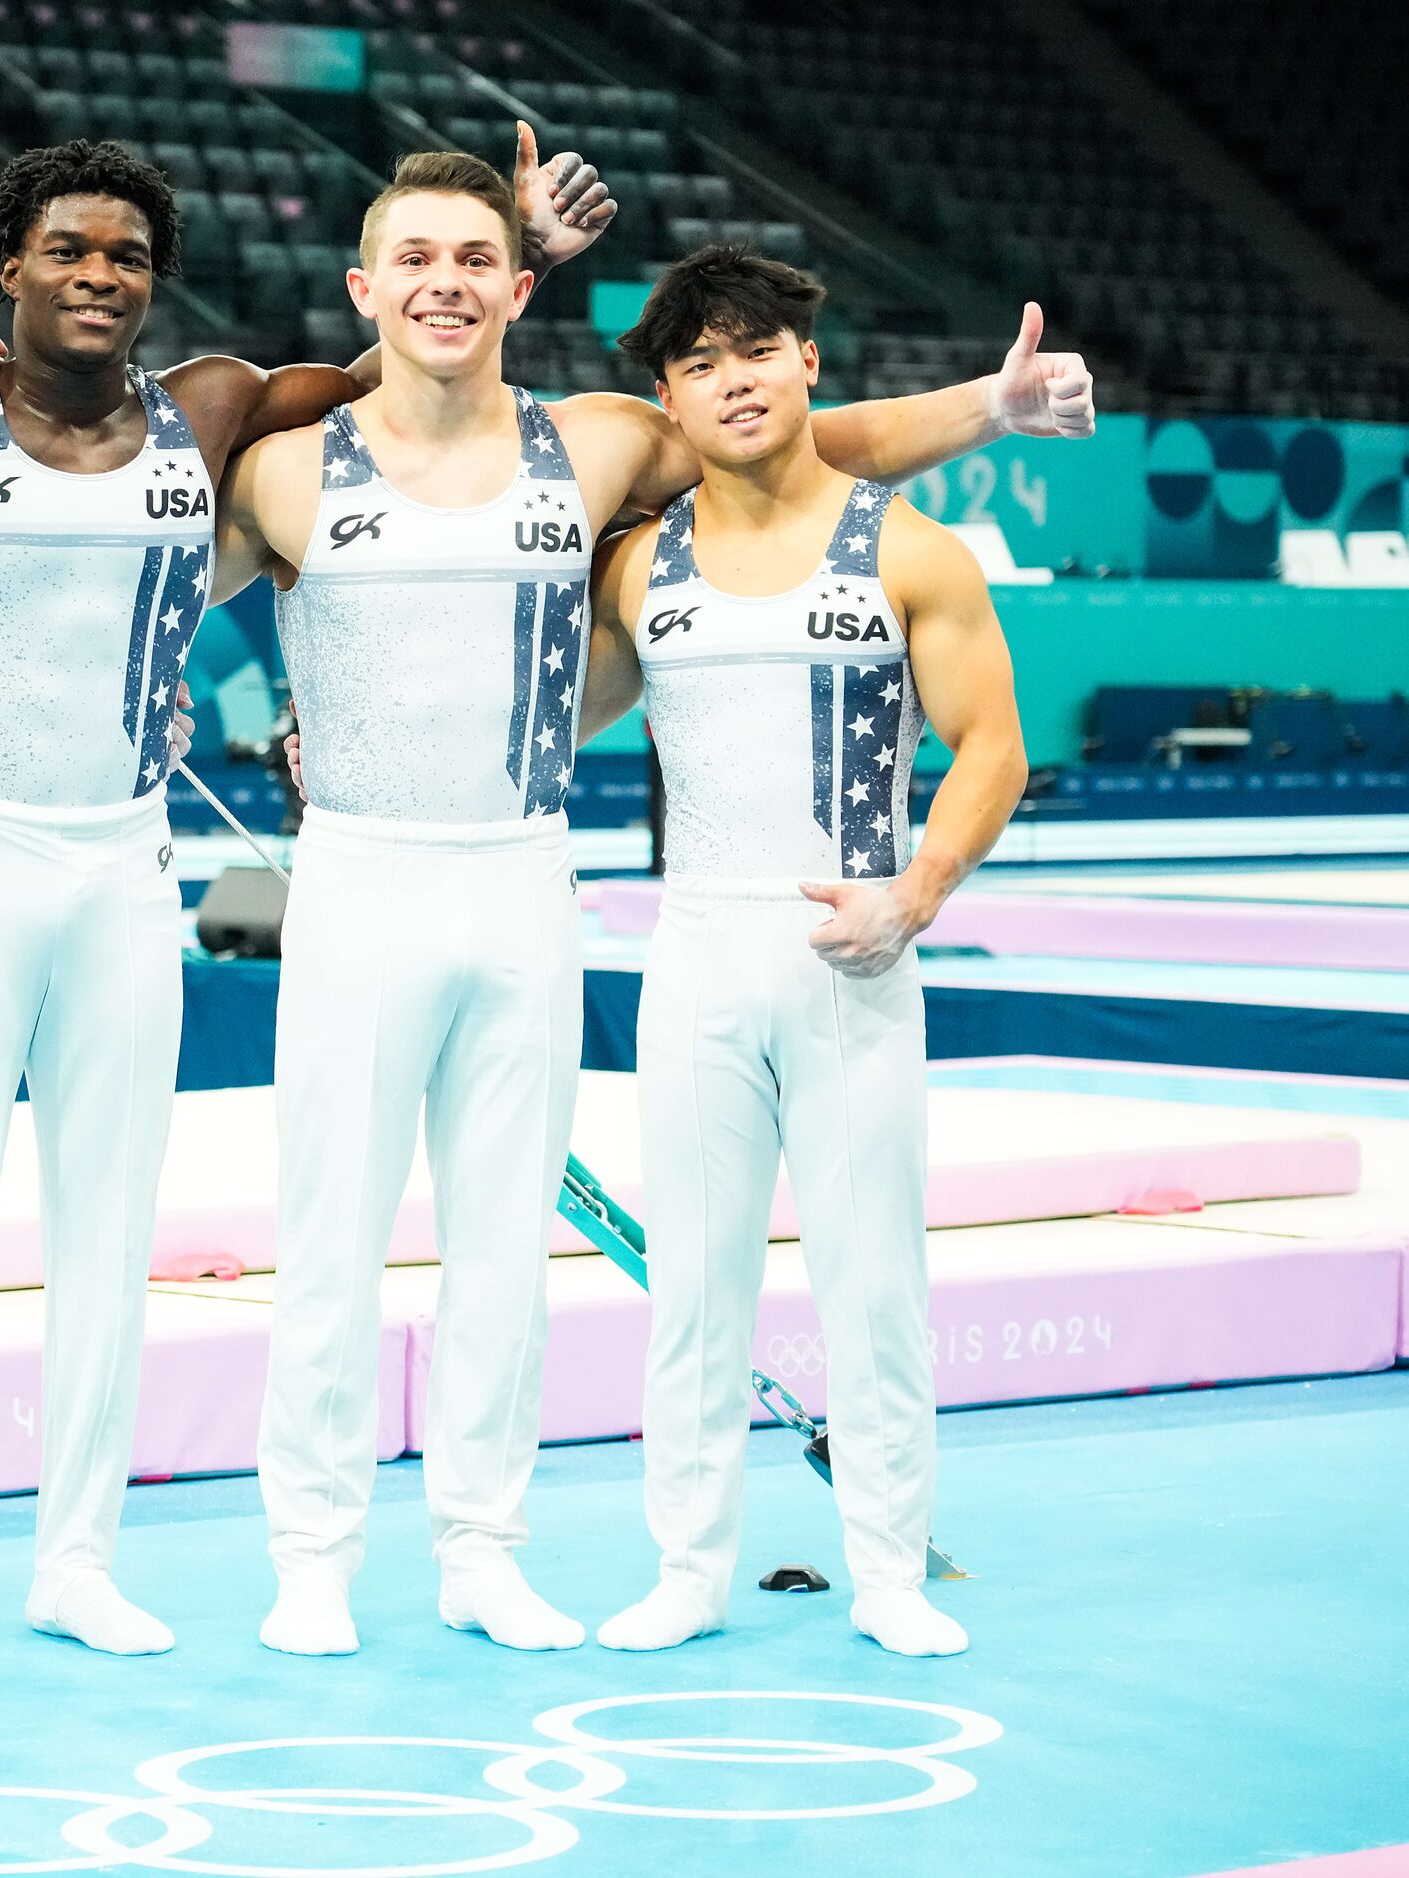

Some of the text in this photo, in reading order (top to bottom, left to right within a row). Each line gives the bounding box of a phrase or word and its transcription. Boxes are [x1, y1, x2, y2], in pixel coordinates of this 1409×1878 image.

[145, 488, 210, 520] USA
[514, 521, 583, 553] USA
[807, 611, 890, 642] USA
[1002, 1314, 1112, 1361] 2024
